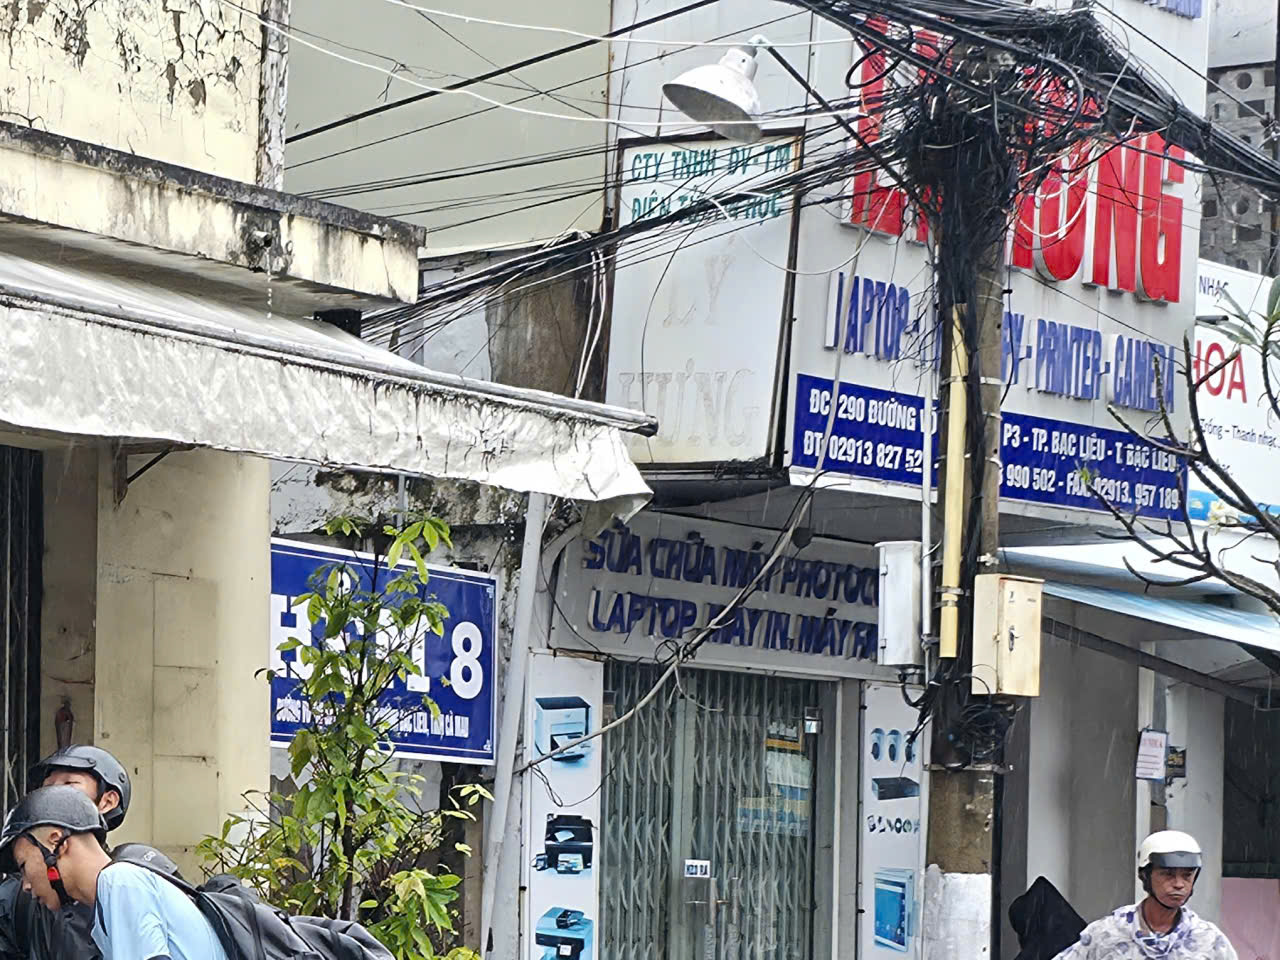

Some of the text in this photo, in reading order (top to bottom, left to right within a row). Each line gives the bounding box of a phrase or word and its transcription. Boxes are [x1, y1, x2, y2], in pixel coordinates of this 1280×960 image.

[632, 153, 664, 181] CTY
[1029, 318, 1102, 400] PRINTER
[838, 394, 865, 422] 290
[868, 397, 917, 431] ĐƯỜNG
[1003, 423, 1020, 448] P3
[1032, 428, 1049, 453] TP.
[1051, 431, 1076, 461] BẠC
[1079, 433, 1106, 462] LIÊU
[1126, 443, 1149, 472] BẠC
[829, 435, 874, 466] 02913
[876, 443, 903, 470] 827
[1006, 464, 1030, 489] 990
[1032, 467, 1056, 493] 502
[1135, 483, 1156, 507] 957
[1159, 486, 1179, 510] 189
[582, 517, 643, 576] SỬA
[650, 531, 716, 585] CHỮA
[587, 587, 698, 639] LAPTOP
[798, 607, 851, 657] MÁY
[450, 621, 484, 700] 8
